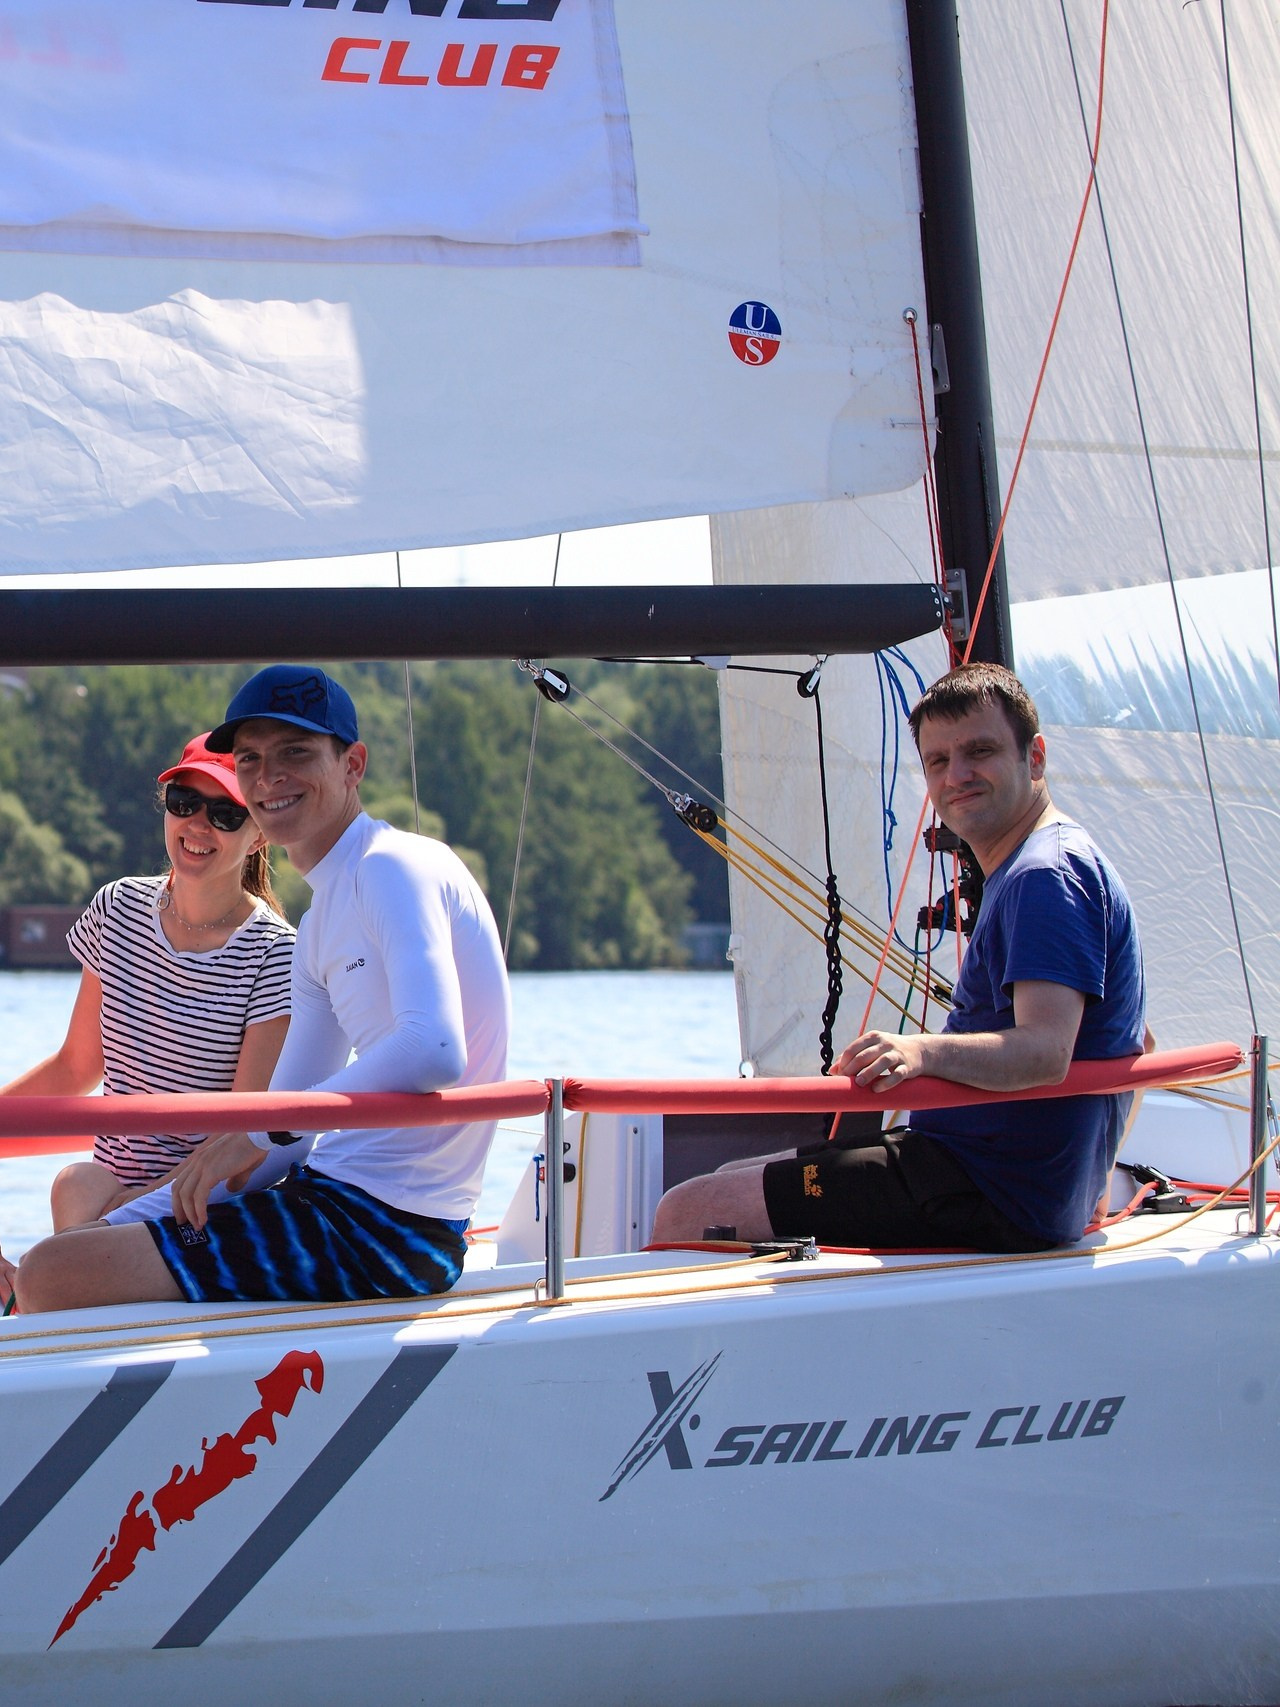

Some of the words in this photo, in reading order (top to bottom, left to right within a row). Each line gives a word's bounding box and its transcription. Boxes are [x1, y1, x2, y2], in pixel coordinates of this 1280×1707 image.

[321, 36, 561, 91] CLUB
[704, 1411, 972, 1468] SAILING
[975, 1396, 1127, 1449] CLUB
